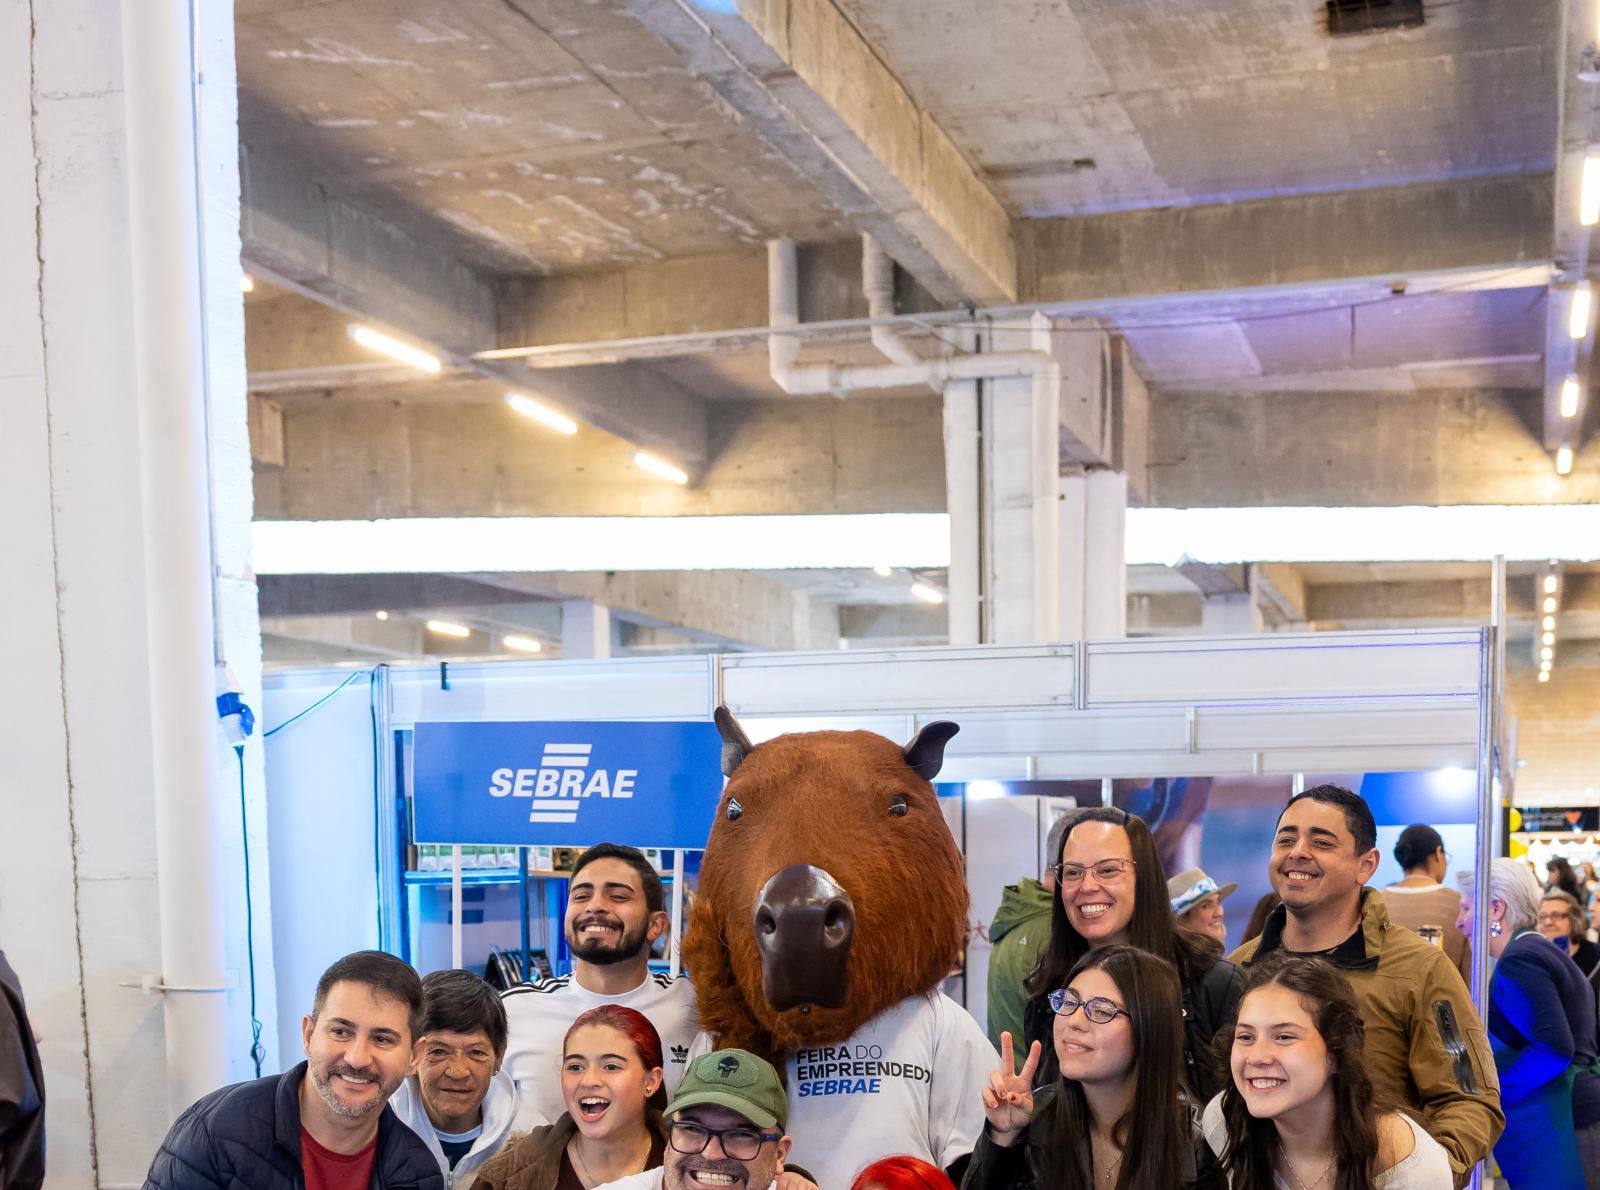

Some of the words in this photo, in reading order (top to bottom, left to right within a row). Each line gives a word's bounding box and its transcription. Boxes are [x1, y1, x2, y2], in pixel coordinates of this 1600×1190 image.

[489, 768, 638, 798] SEBRAE
[797, 1046, 851, 1063] FEIRA
[855, 1044, 882, 1060] DO
[798, 1078, 882, 1097] SEBRAE
